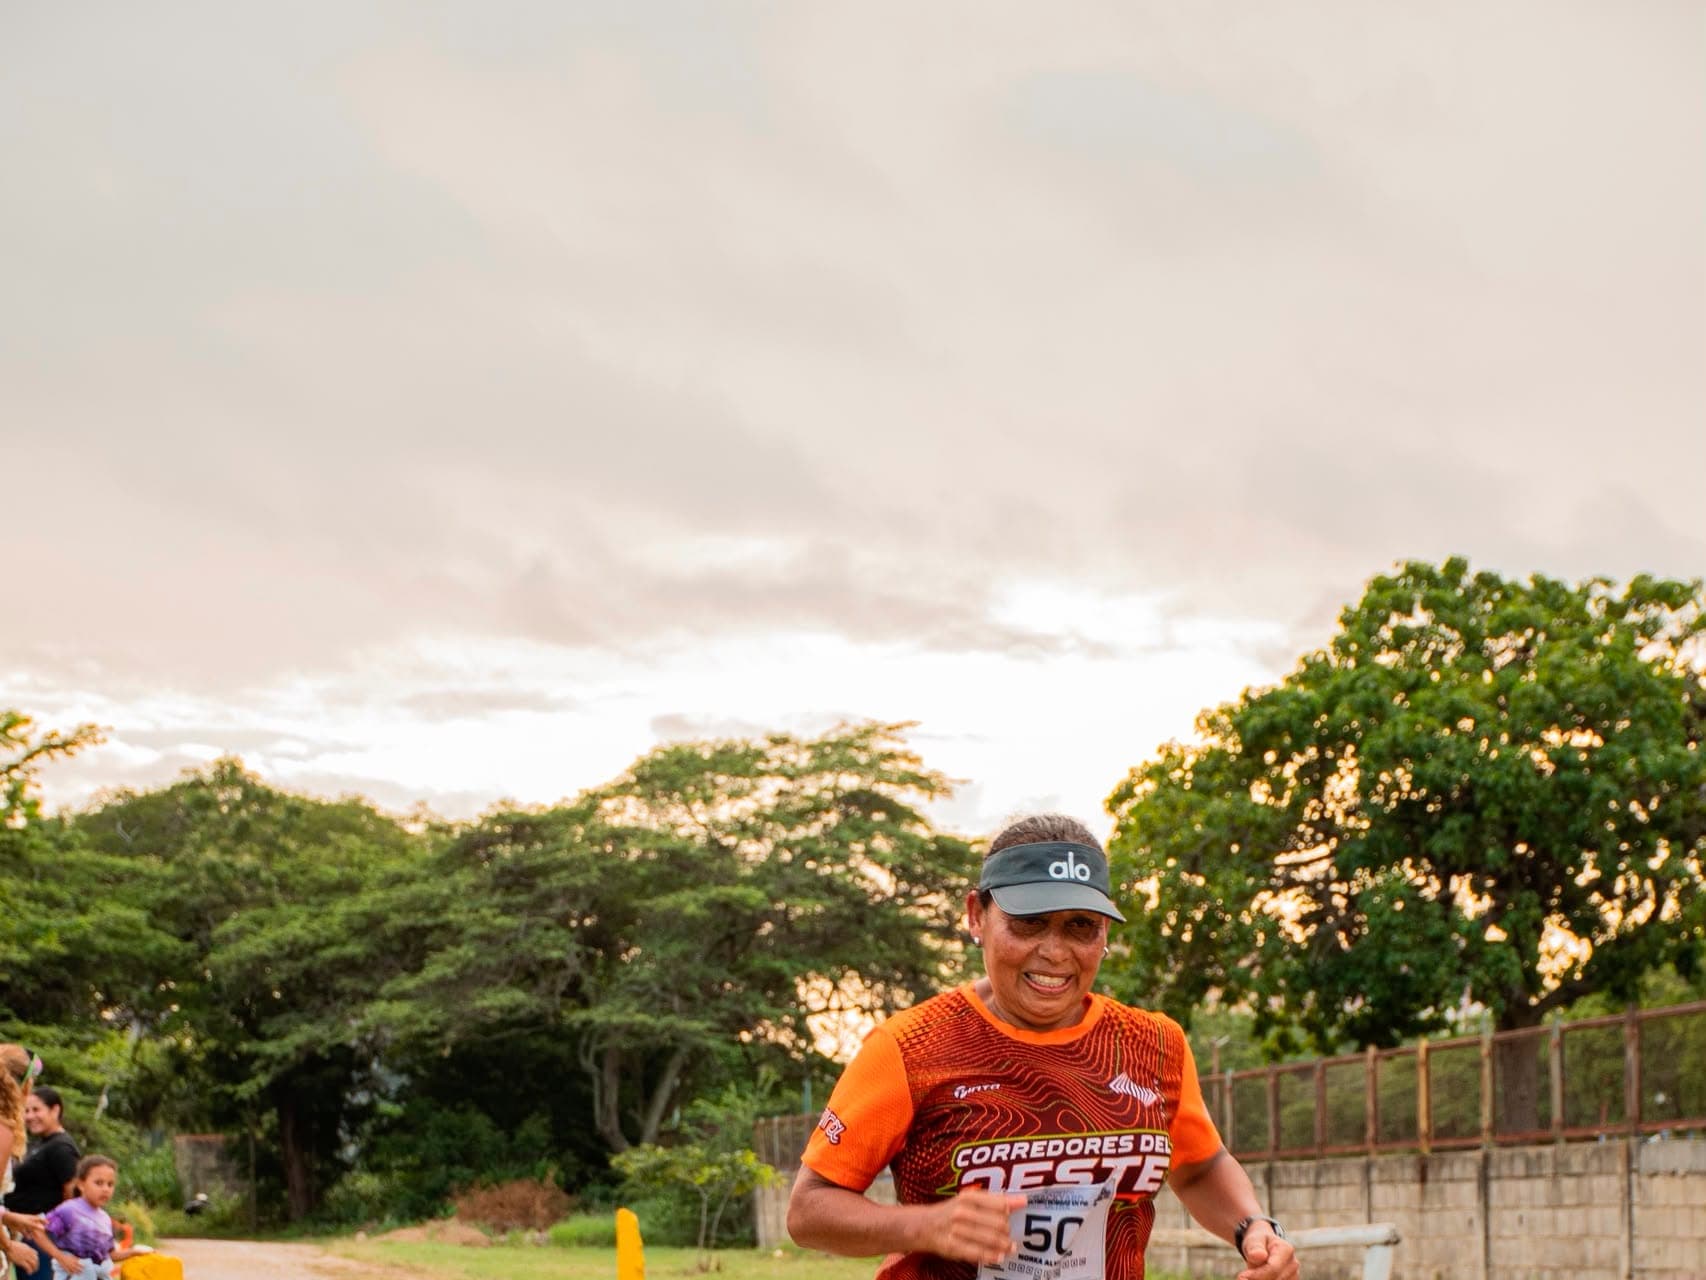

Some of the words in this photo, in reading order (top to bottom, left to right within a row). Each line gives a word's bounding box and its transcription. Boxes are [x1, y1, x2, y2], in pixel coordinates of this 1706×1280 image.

[1049, 851, 1090, 881] alo
[956, 1135, 1133, 1168] CORREDORES
[1140, 1134, 1171, 1153] DEL
